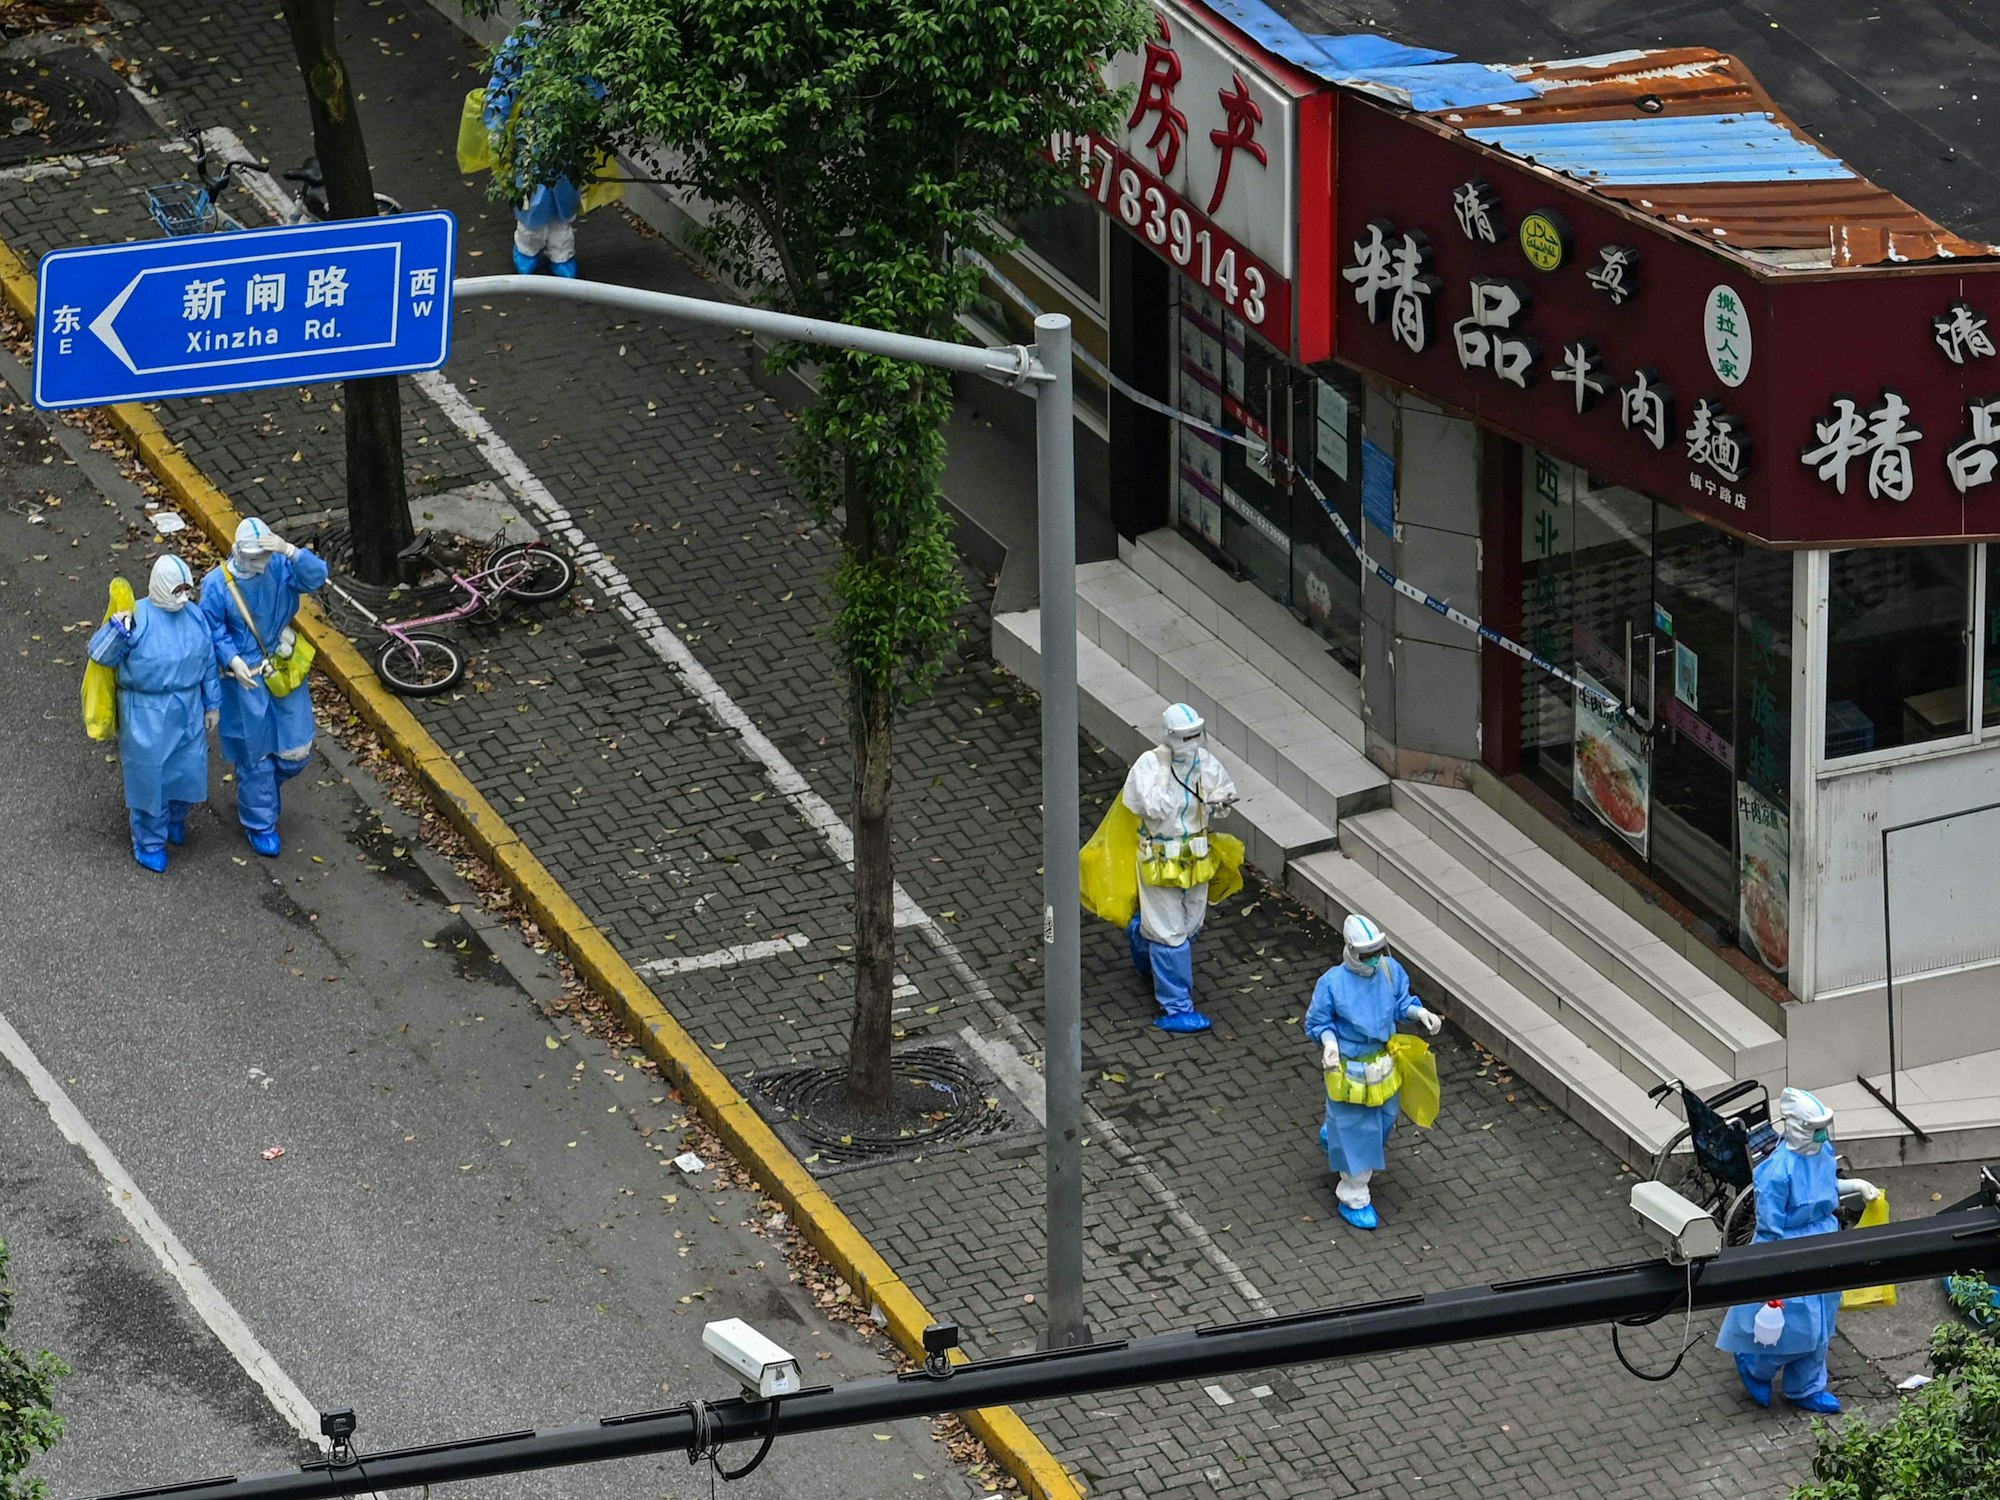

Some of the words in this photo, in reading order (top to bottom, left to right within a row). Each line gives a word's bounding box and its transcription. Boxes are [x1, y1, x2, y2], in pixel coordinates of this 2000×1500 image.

[1127, 12, 1268, 216] 房产
[182, 266, 350, 322] 新闸路
[409, 268, 439, 298] 西
[52, 305, 82, 336] 东
[412, 301, 434, 318] W
[59, 338, 73, 354] E
[186, 324, 279, 353] Xinzha
[304, 319, 342, 341] Rd.
[1689, 471, 1747, 511] 镇宁路店
